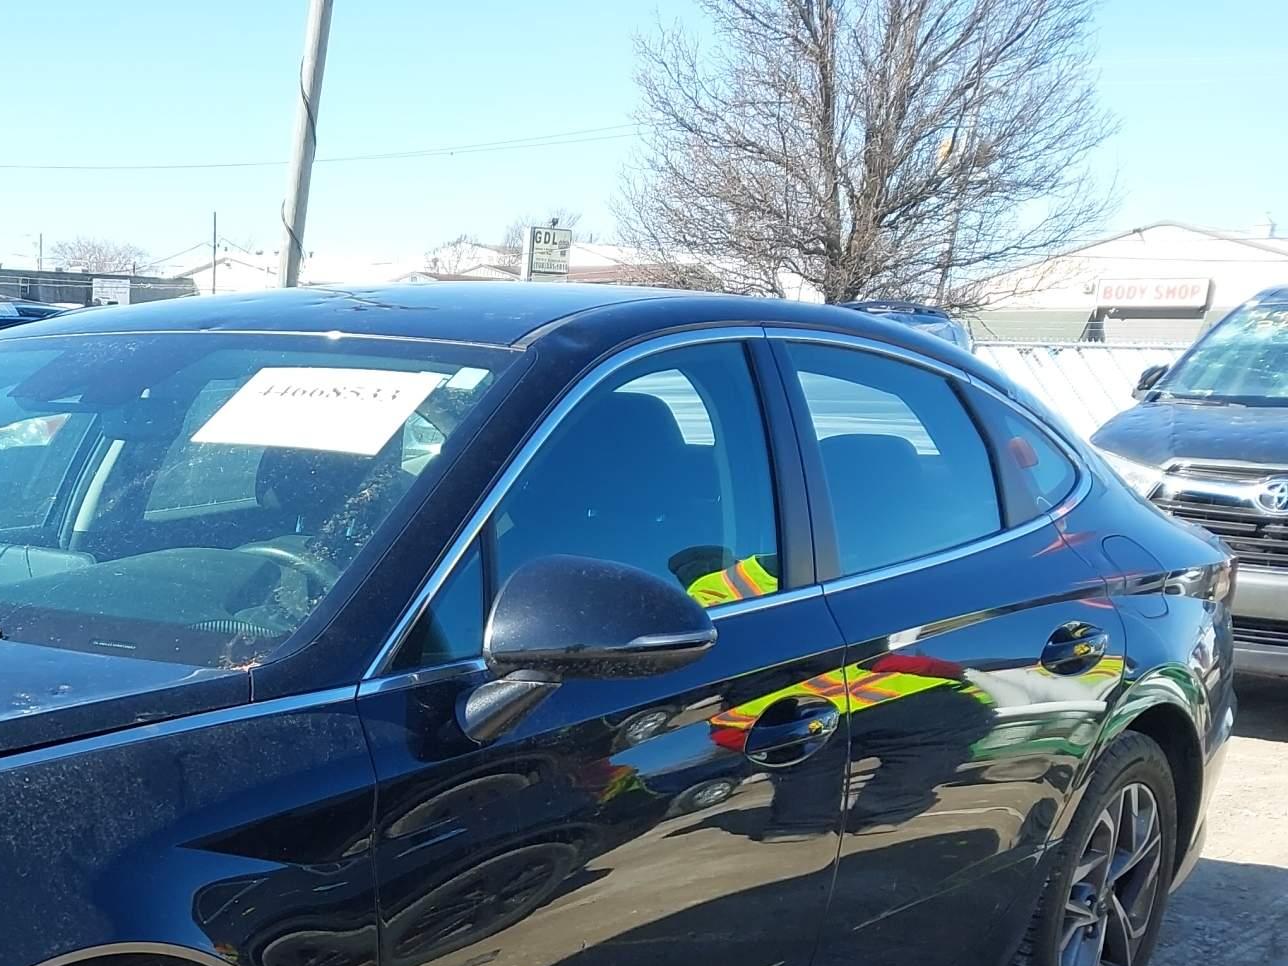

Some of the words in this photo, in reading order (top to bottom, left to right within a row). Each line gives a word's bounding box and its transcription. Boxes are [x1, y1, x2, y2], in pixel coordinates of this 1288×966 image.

[535, 230, 558, 246] GDL
[1102, 285, 1148, 300] BODY
[1153, 283, 1201, 300] SHOP
